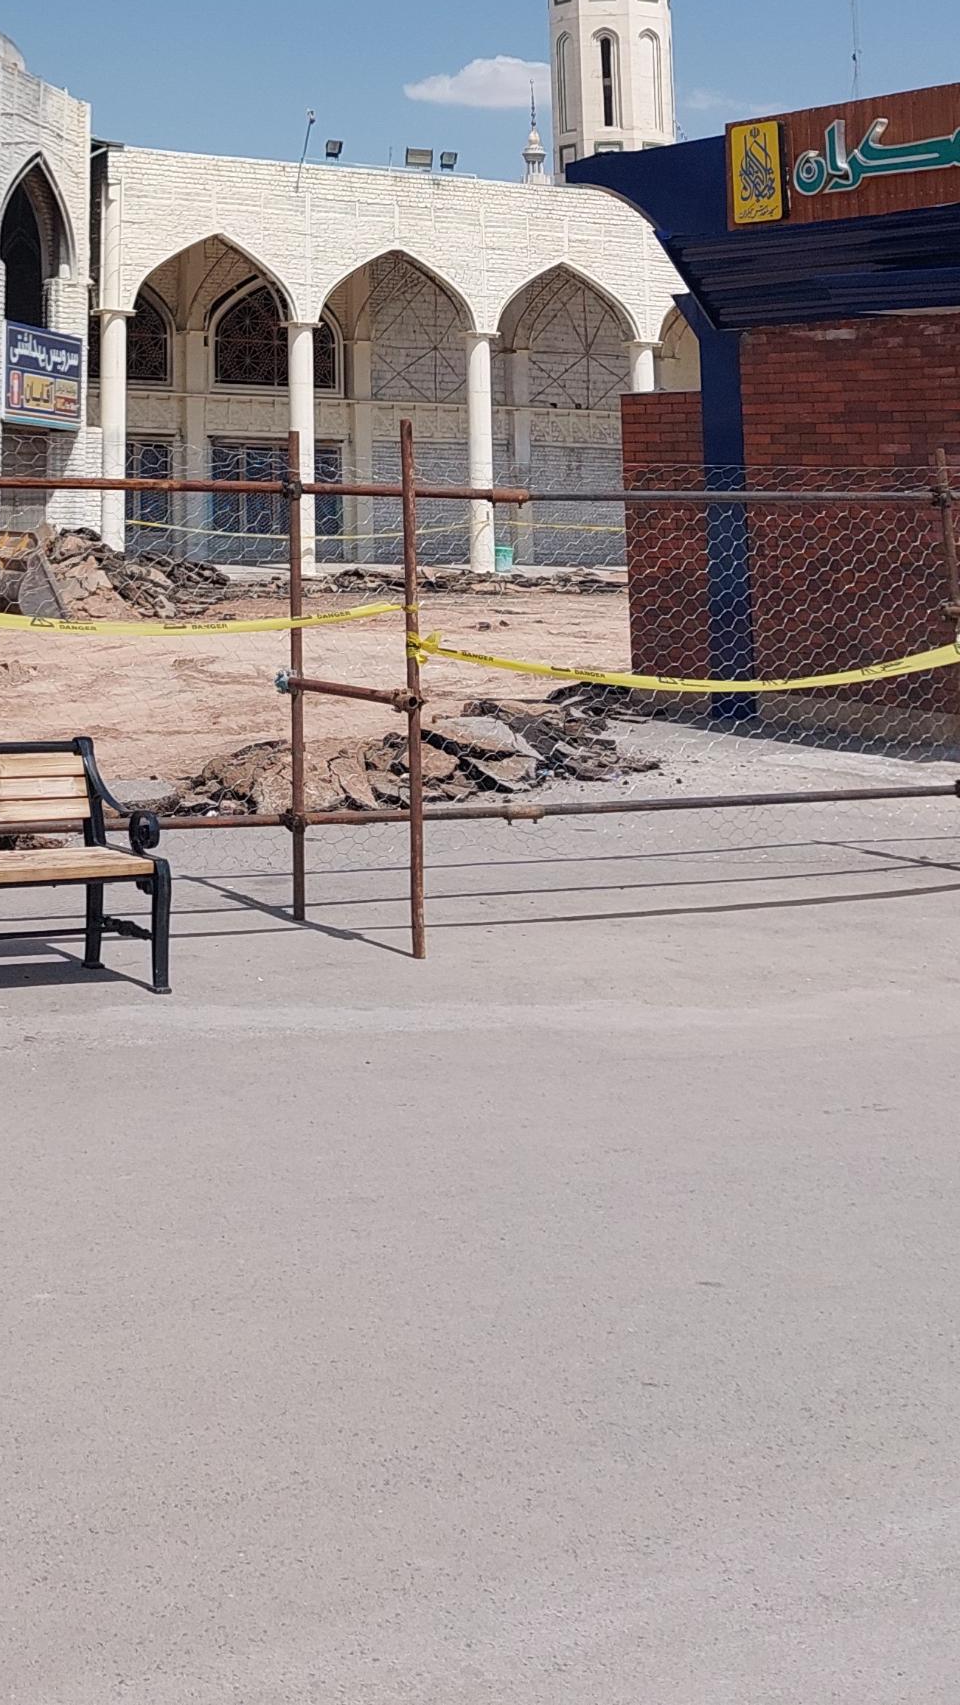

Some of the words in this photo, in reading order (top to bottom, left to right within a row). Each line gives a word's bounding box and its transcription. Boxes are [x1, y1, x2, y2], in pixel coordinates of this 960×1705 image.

[10, 332, 47, 367] بهداشتی
[46, 348, 79, 372] سرویس
[58, 623, 98, 631] DANGER
